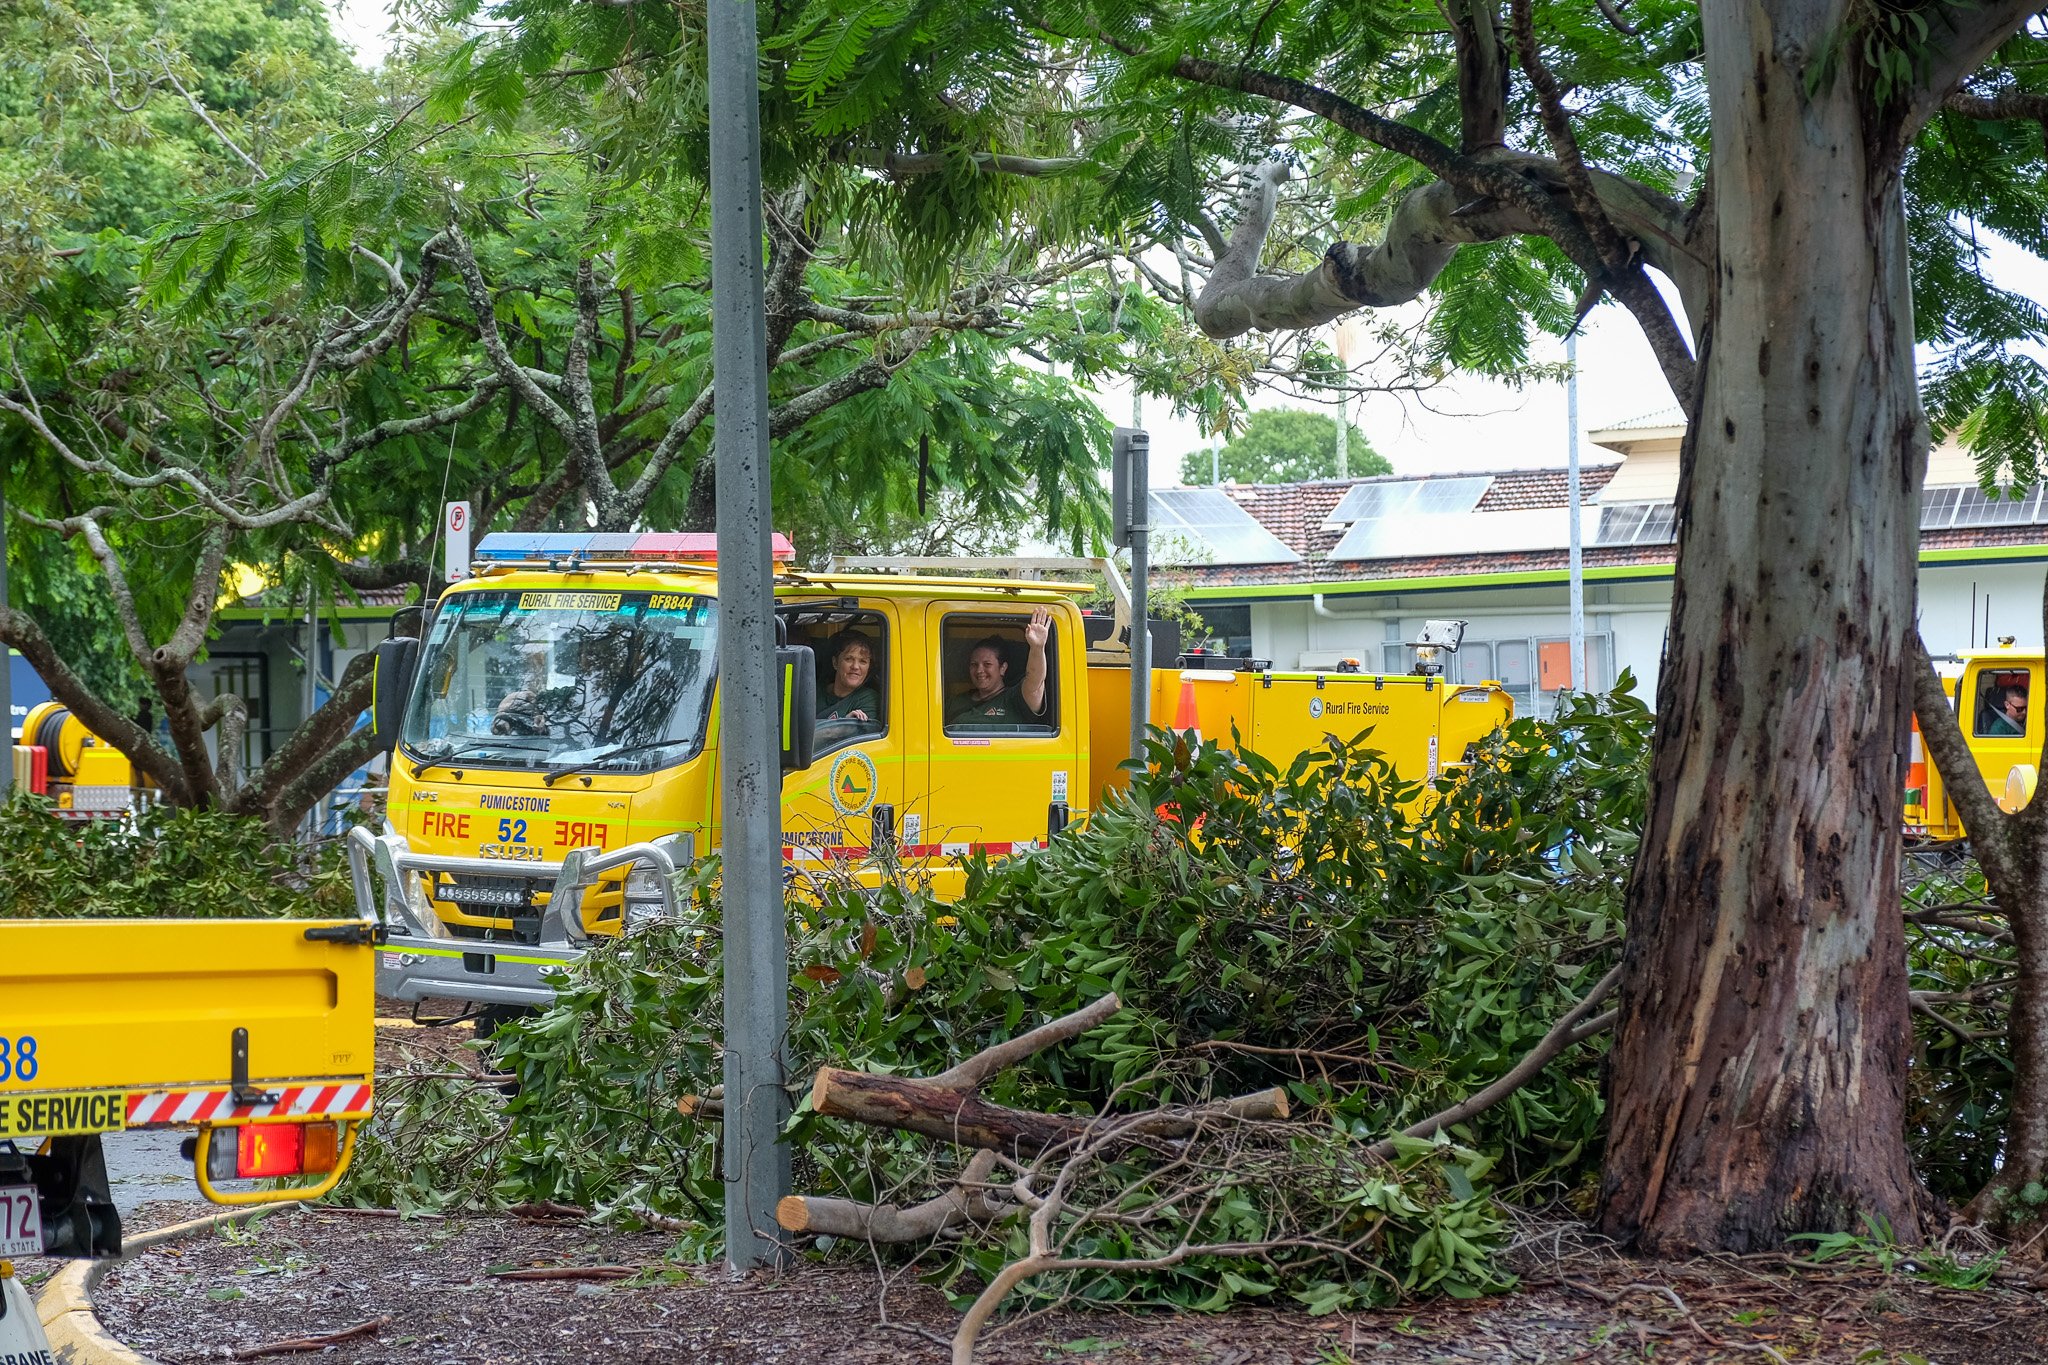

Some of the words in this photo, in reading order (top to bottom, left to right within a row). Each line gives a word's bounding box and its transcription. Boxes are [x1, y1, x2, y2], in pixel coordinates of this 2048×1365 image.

[521, 594, 551, 608] RURAL
[553, 594, 577, 608] FIRE
[576, 594, 619, 610] SERVICE
[648, 594, 694, 611] RF8844
[1325, 701, 1346, 715] Rural
[1347, 702, 1361, 715] Fire
[1362, 702, 1390, 715] Service
[835, 763, 846, 784] RURAL
[845, 757, 857, 765] FIRE
[856, 758, 872, 782] SERVICE
[479, 794, 551, 813] PUMICESTONE
[839, 795, 869, 810] QUEENSLAND
[422, 811, 471, 839] FIRE
[497, 818, 528, 843] 52
[479, 842, 544, 862] ISUZU
[16, 1094, 122, 1133] SERVICE
[10, 1241, 36, 1254] STATE
